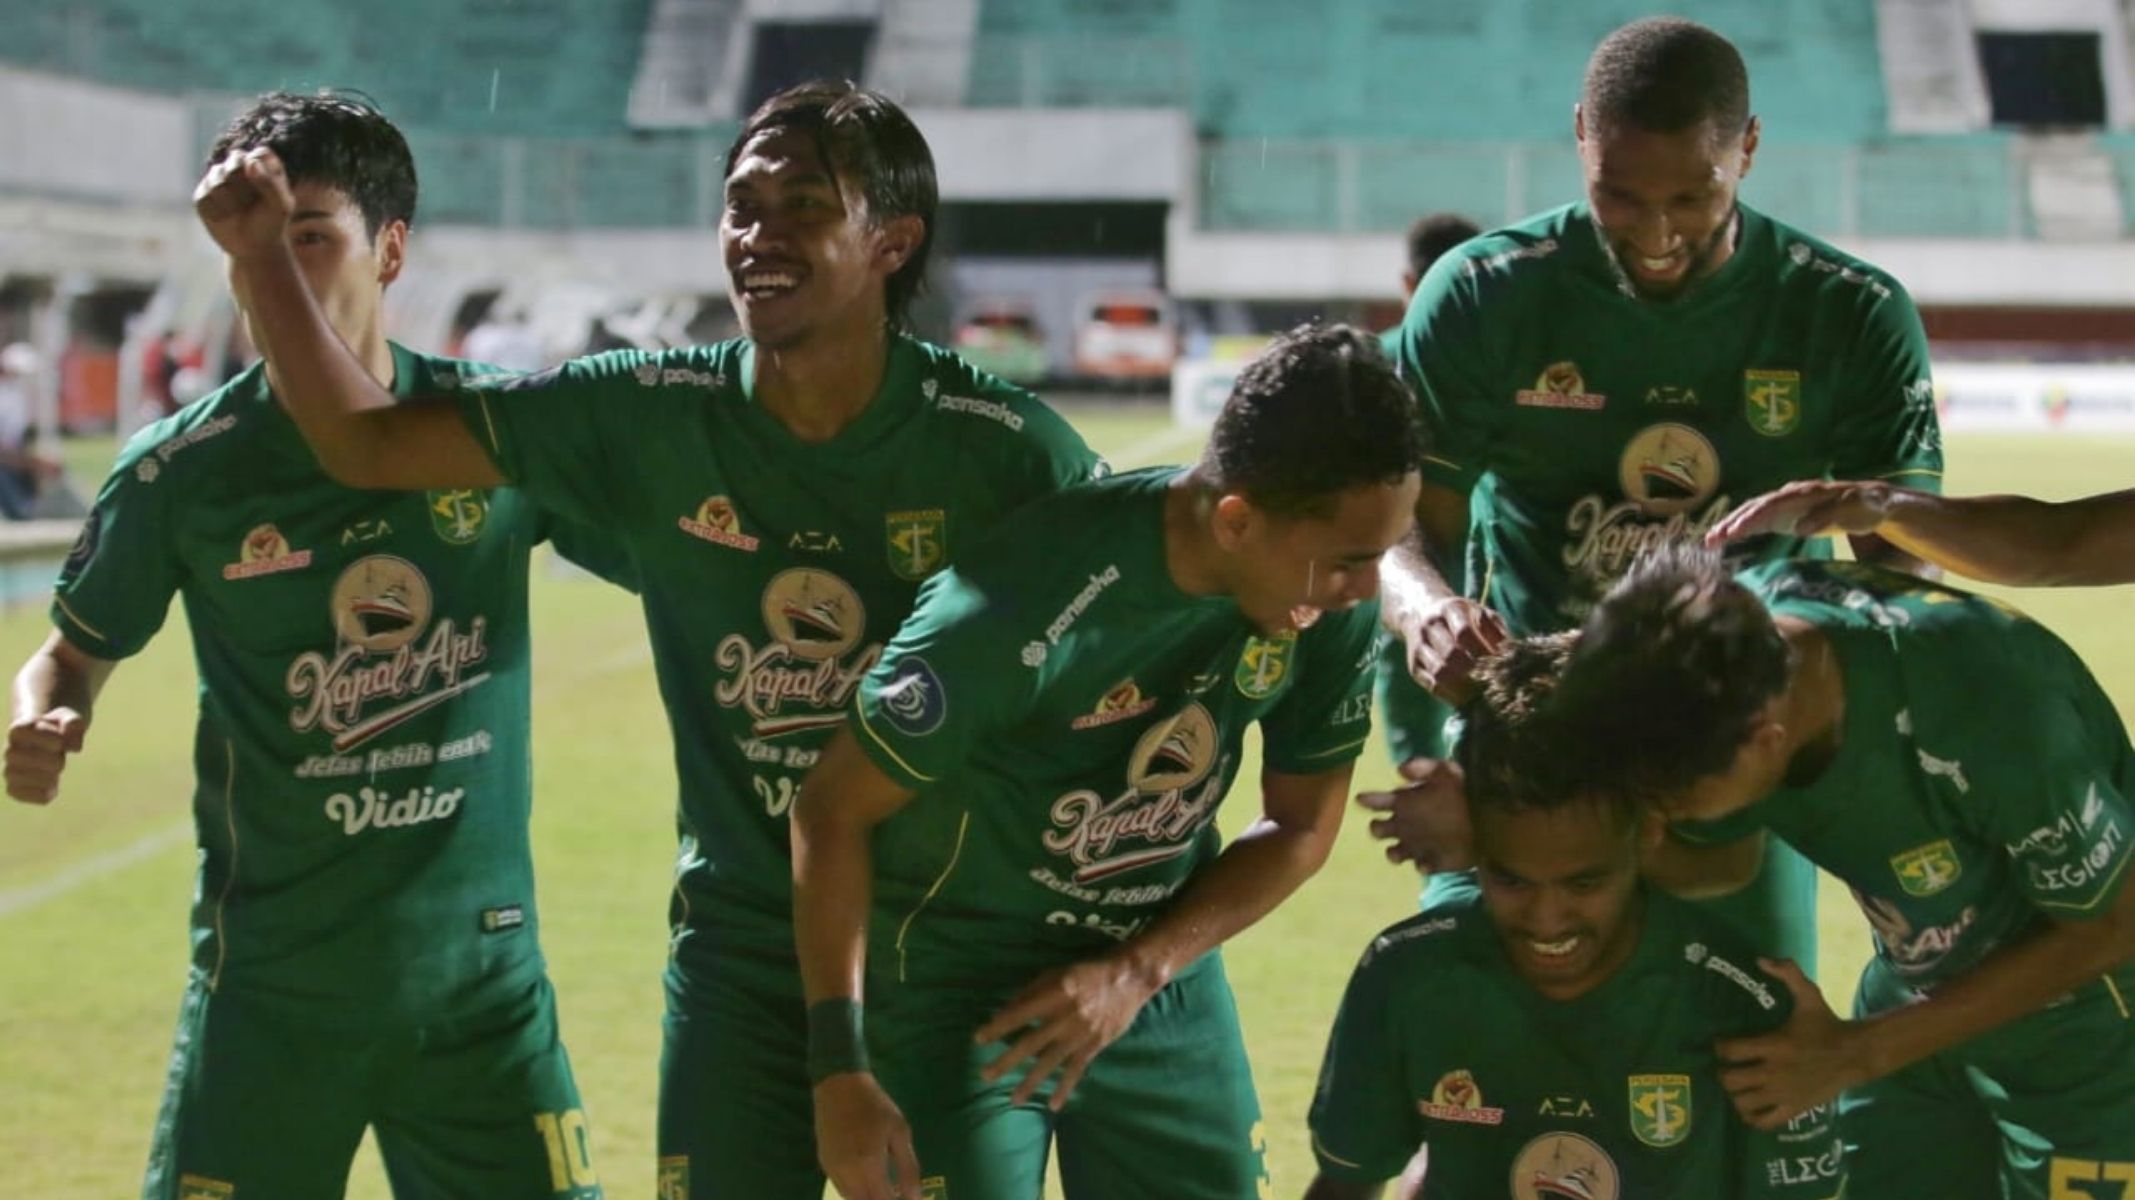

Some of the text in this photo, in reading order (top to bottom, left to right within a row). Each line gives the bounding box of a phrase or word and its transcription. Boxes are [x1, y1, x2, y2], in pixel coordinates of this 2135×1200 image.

[286, 618, 487, 735] Kapal Api
[324, 785, 465, 836] Vidio
[534, 1109, 597, 1192] 10
